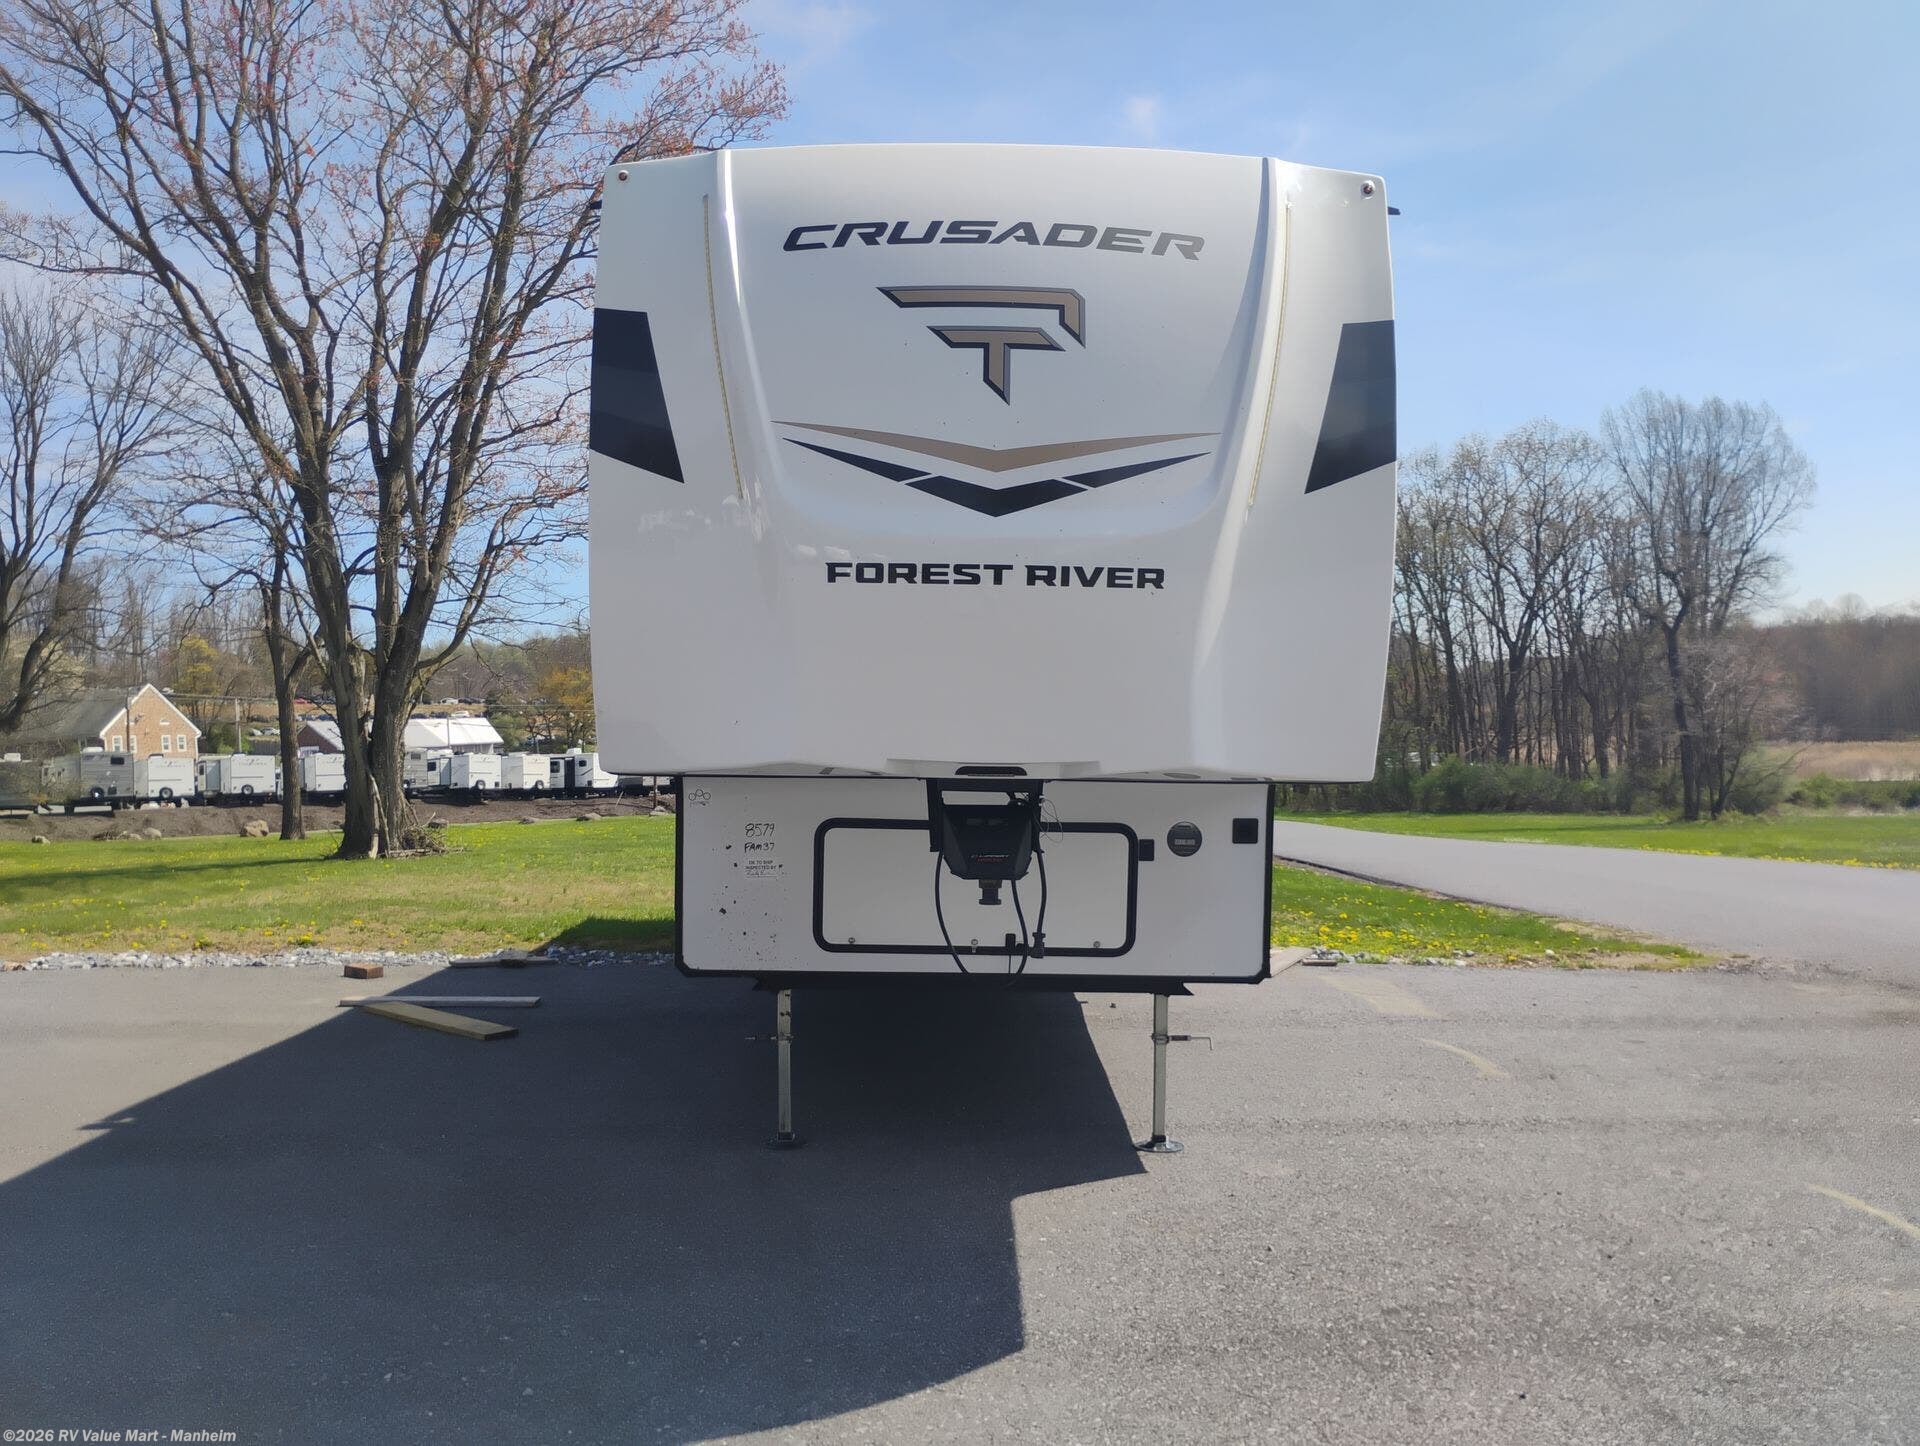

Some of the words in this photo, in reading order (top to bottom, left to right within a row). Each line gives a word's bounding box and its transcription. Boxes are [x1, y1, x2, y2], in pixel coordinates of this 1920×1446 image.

[783, 221, 1205, 260] CRUSADER
[825, 562, 1013, 586] FOREST
[1025, 565, 1165, 589] RIVER
[745, 823, 775, 837] 8579
